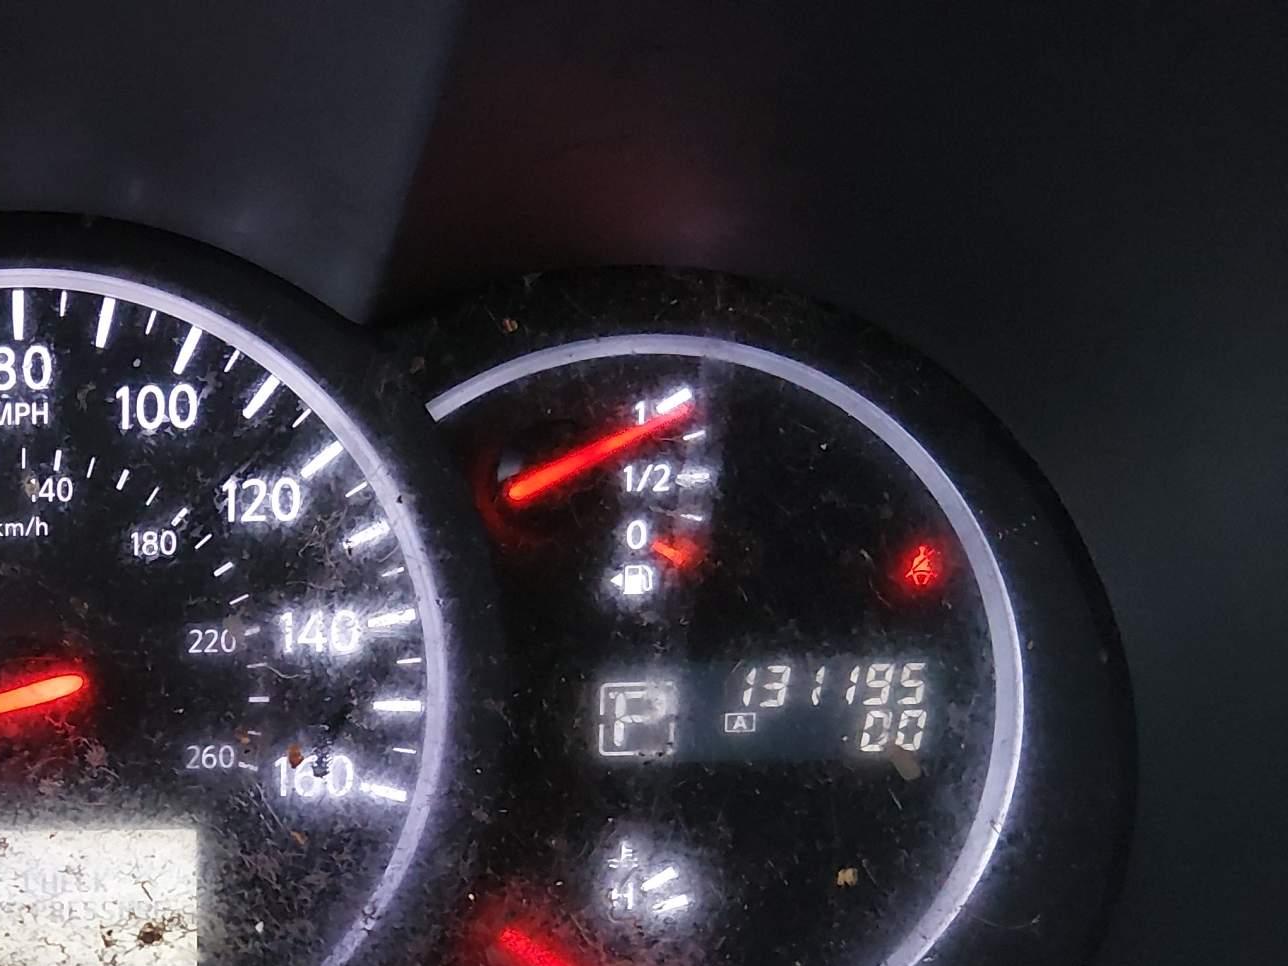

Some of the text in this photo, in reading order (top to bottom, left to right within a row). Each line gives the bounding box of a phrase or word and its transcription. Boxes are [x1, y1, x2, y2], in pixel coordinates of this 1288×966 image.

[115, 383, 198, 430] 100
[634, 400, 646, 425] 1
[623, 463, 672, 493] 1/2
[221, 476, 301, 523] 120
[130, 530, 178, 556] 180
[626, 519, 648, 550] 0
[187, 628, 237, 654] 220
[279, 609, 360, 653] 140
[742, 662, 927, 707] 131195
[185, 745, 235, 770] 260
[274, 754, 354, 798] 160
